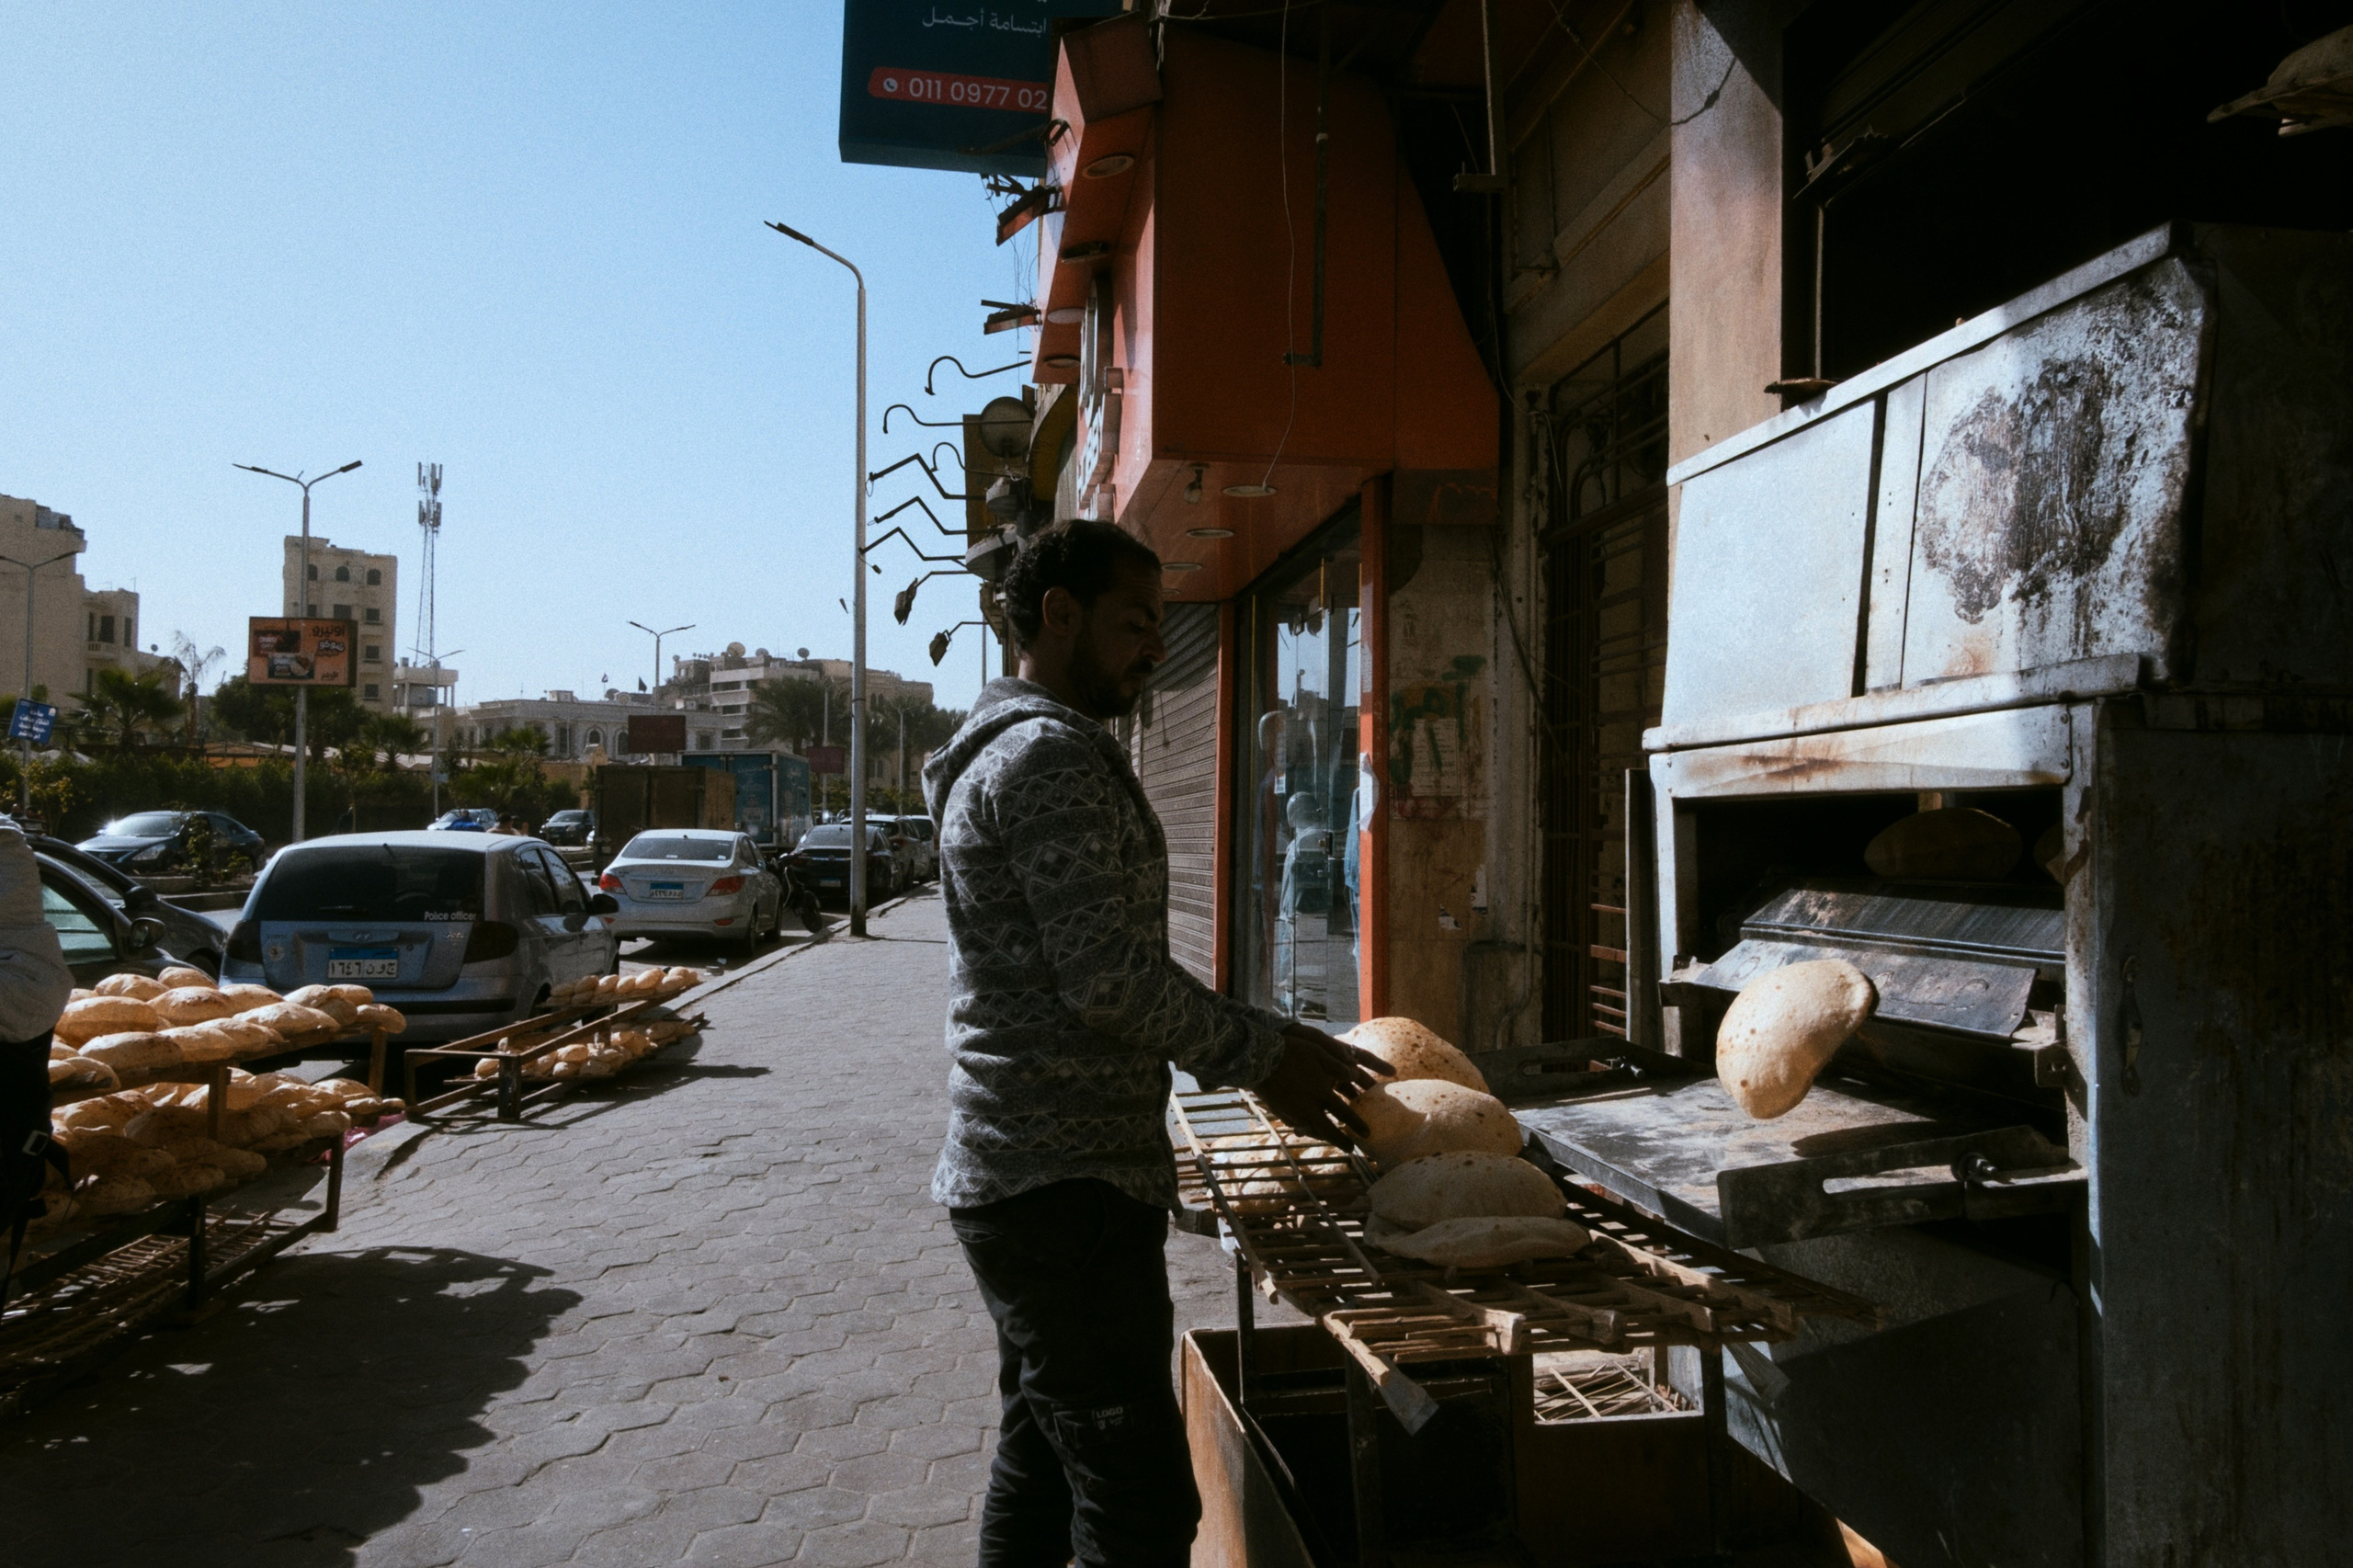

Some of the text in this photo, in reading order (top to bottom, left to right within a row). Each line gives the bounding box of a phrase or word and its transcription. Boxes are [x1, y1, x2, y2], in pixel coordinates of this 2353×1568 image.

[922, 6, 1047, 38] ابتسامة أجمل
[908, 77, 941, 100] 011
[950, 81, 1010, 106] 0977
[424, 911, 477, 921] Police officer
